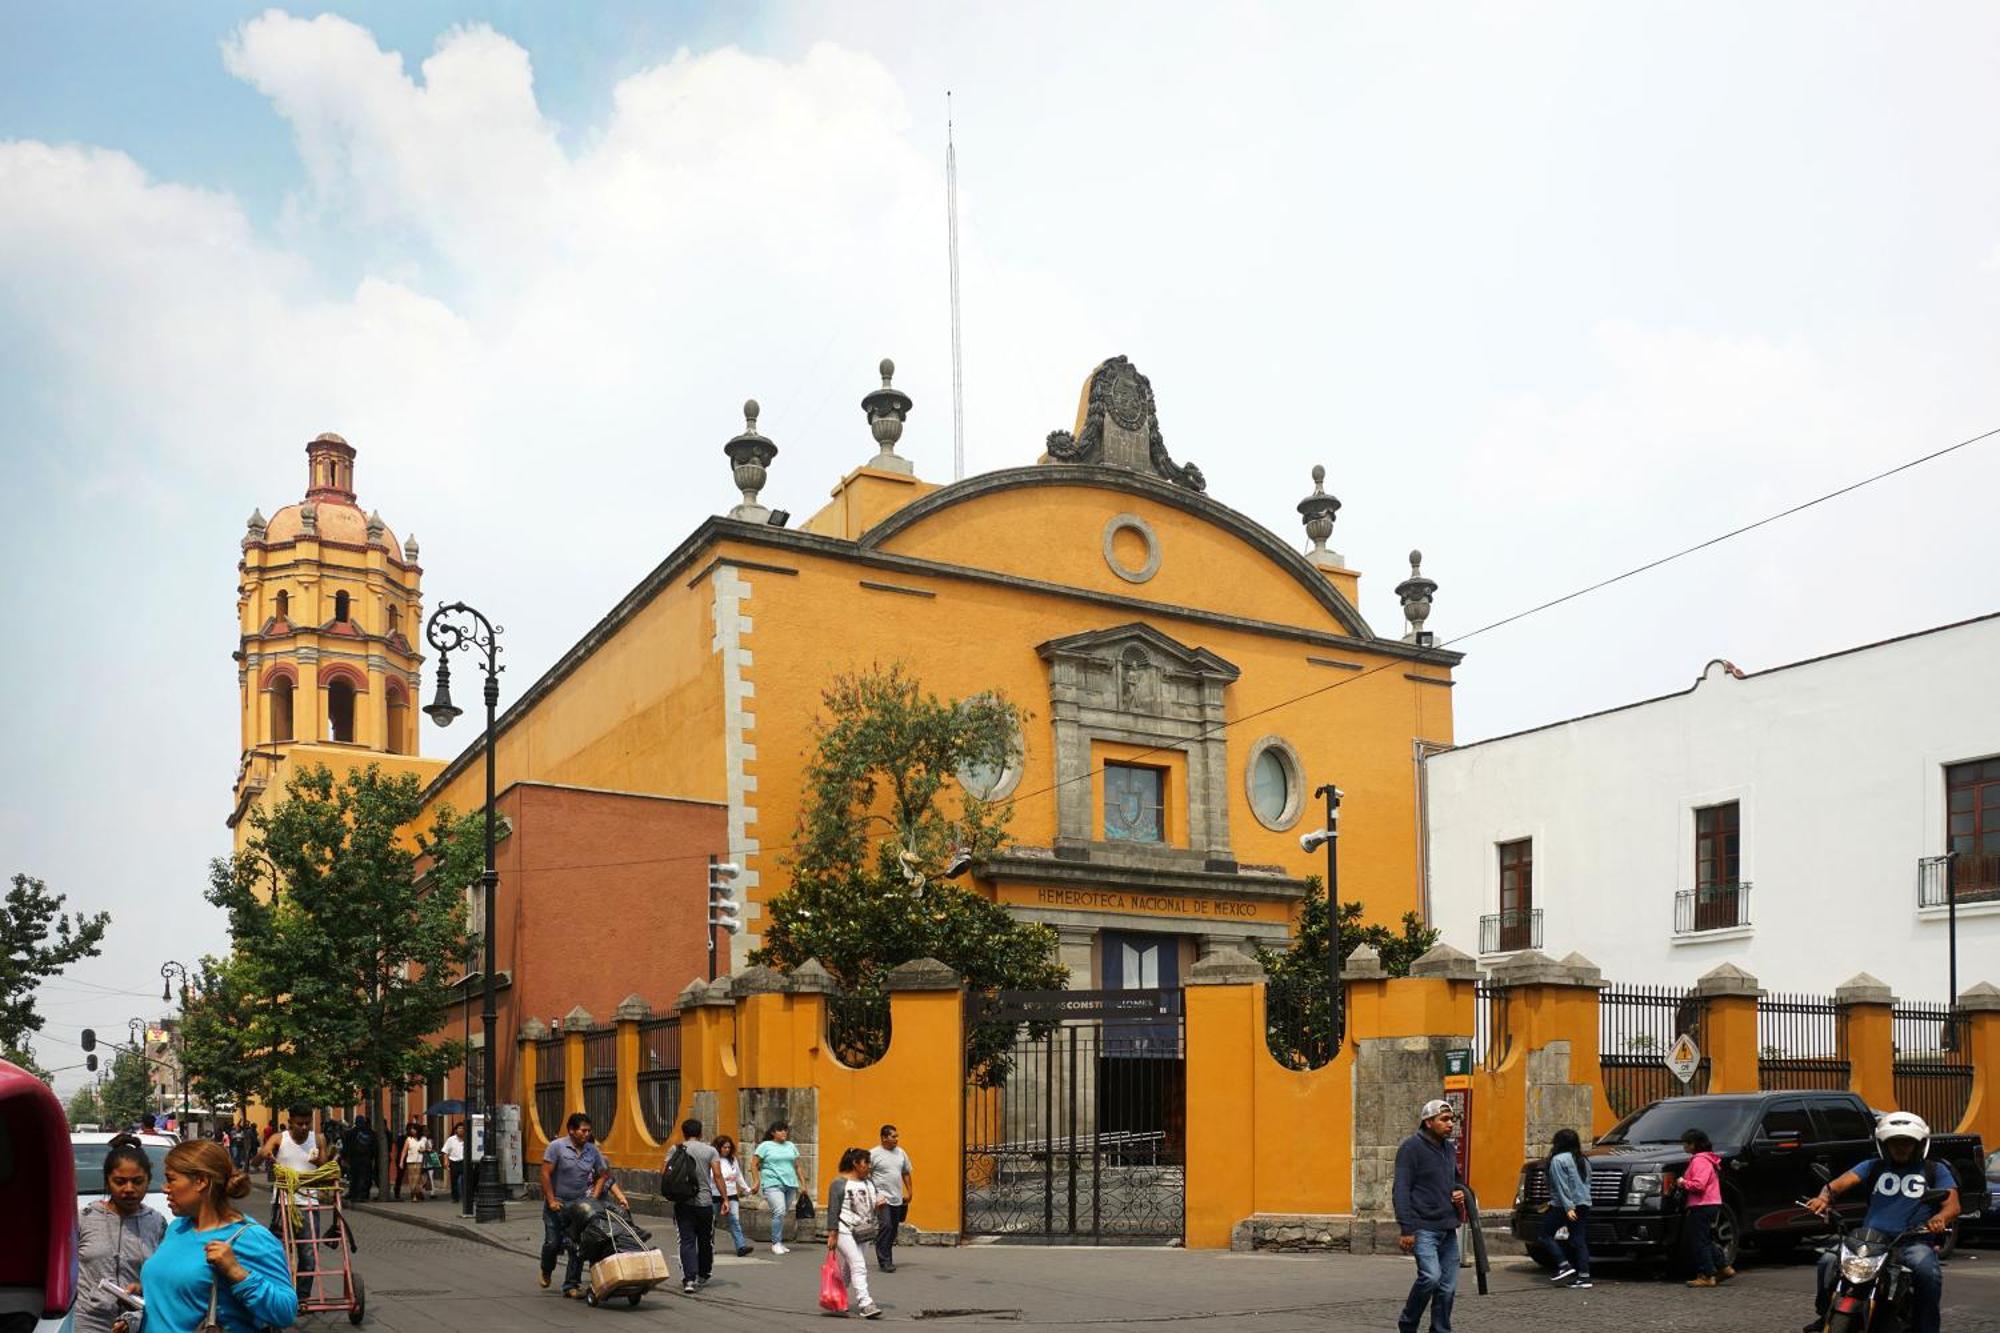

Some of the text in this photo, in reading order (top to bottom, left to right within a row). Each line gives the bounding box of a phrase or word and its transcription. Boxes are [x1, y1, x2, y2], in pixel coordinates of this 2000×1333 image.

[1038, 888, 1257, 917] HEMEROTECA NACIONAL DE MEXICO
